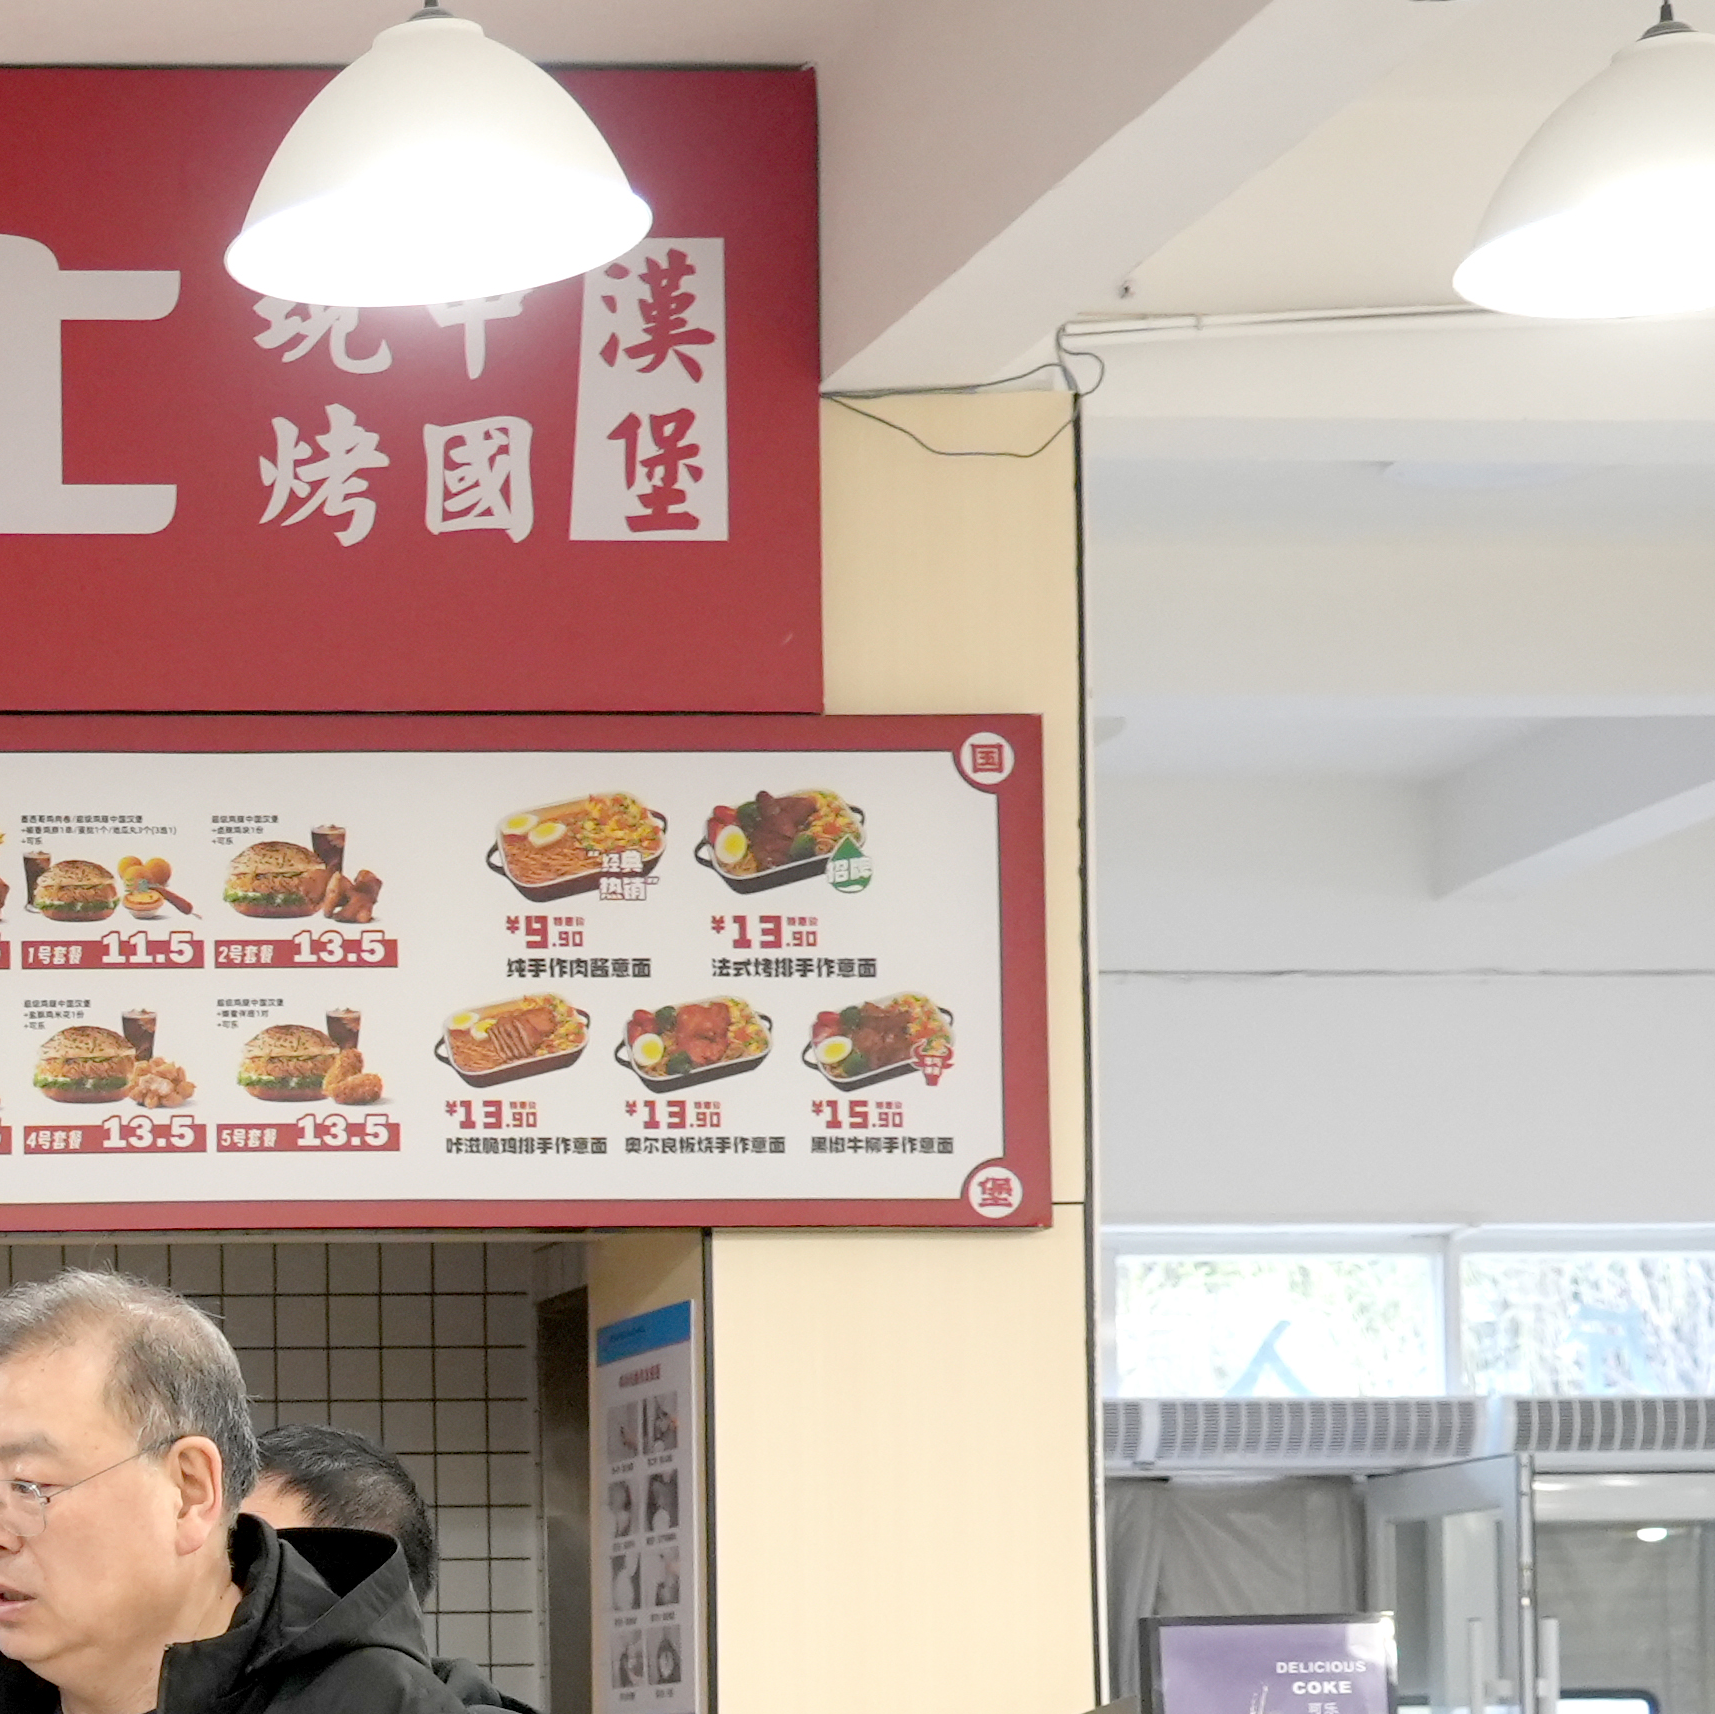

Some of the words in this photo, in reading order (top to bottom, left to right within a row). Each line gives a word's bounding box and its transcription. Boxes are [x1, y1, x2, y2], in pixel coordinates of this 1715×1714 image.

[599, 248, 717, 533] 漢堡
[971, 743, 1003, 774] 国
[101, 931, 194, 964] 11.5
[218, 945, 274, 964] 2号套餐
[293, 930, 385, 963] 13.5
[26, 1130, 83, 1150] 4号套餐
[102, 1115, 195, 1148] 13.5
[221, 1129, 277, 1148] 5号套餐
[297, 1114, 389, 1147] 13.5
[978, 1176, 1013, 1209] 堡
[1275, 1660, 1367, 1674] DELICIOUS
[1292, 1680, 1353, 1695] COKE
